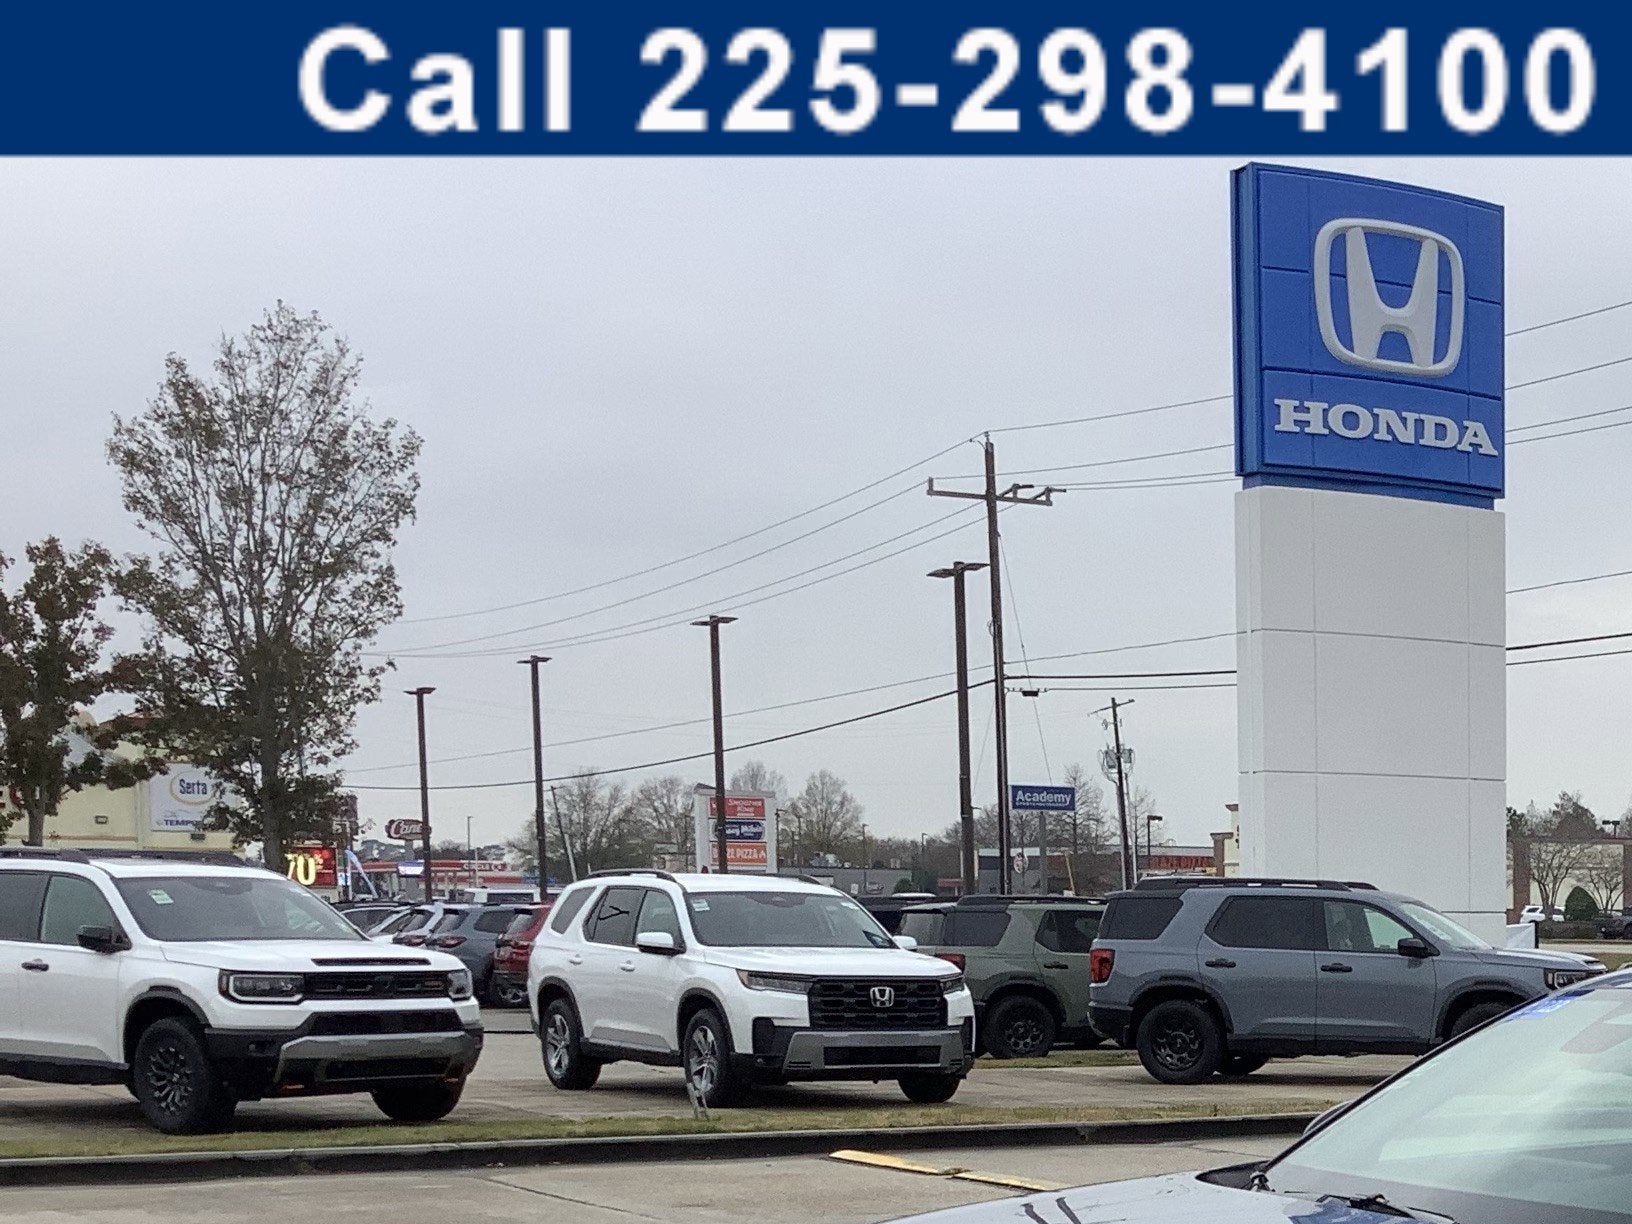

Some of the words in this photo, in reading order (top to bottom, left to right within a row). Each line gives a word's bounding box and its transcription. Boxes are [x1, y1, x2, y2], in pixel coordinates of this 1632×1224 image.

[1274, 398, 1499, 457] HONDA
[179, 779, 208, 795] Serta
[1015, 789, 1072, 806] Academy
